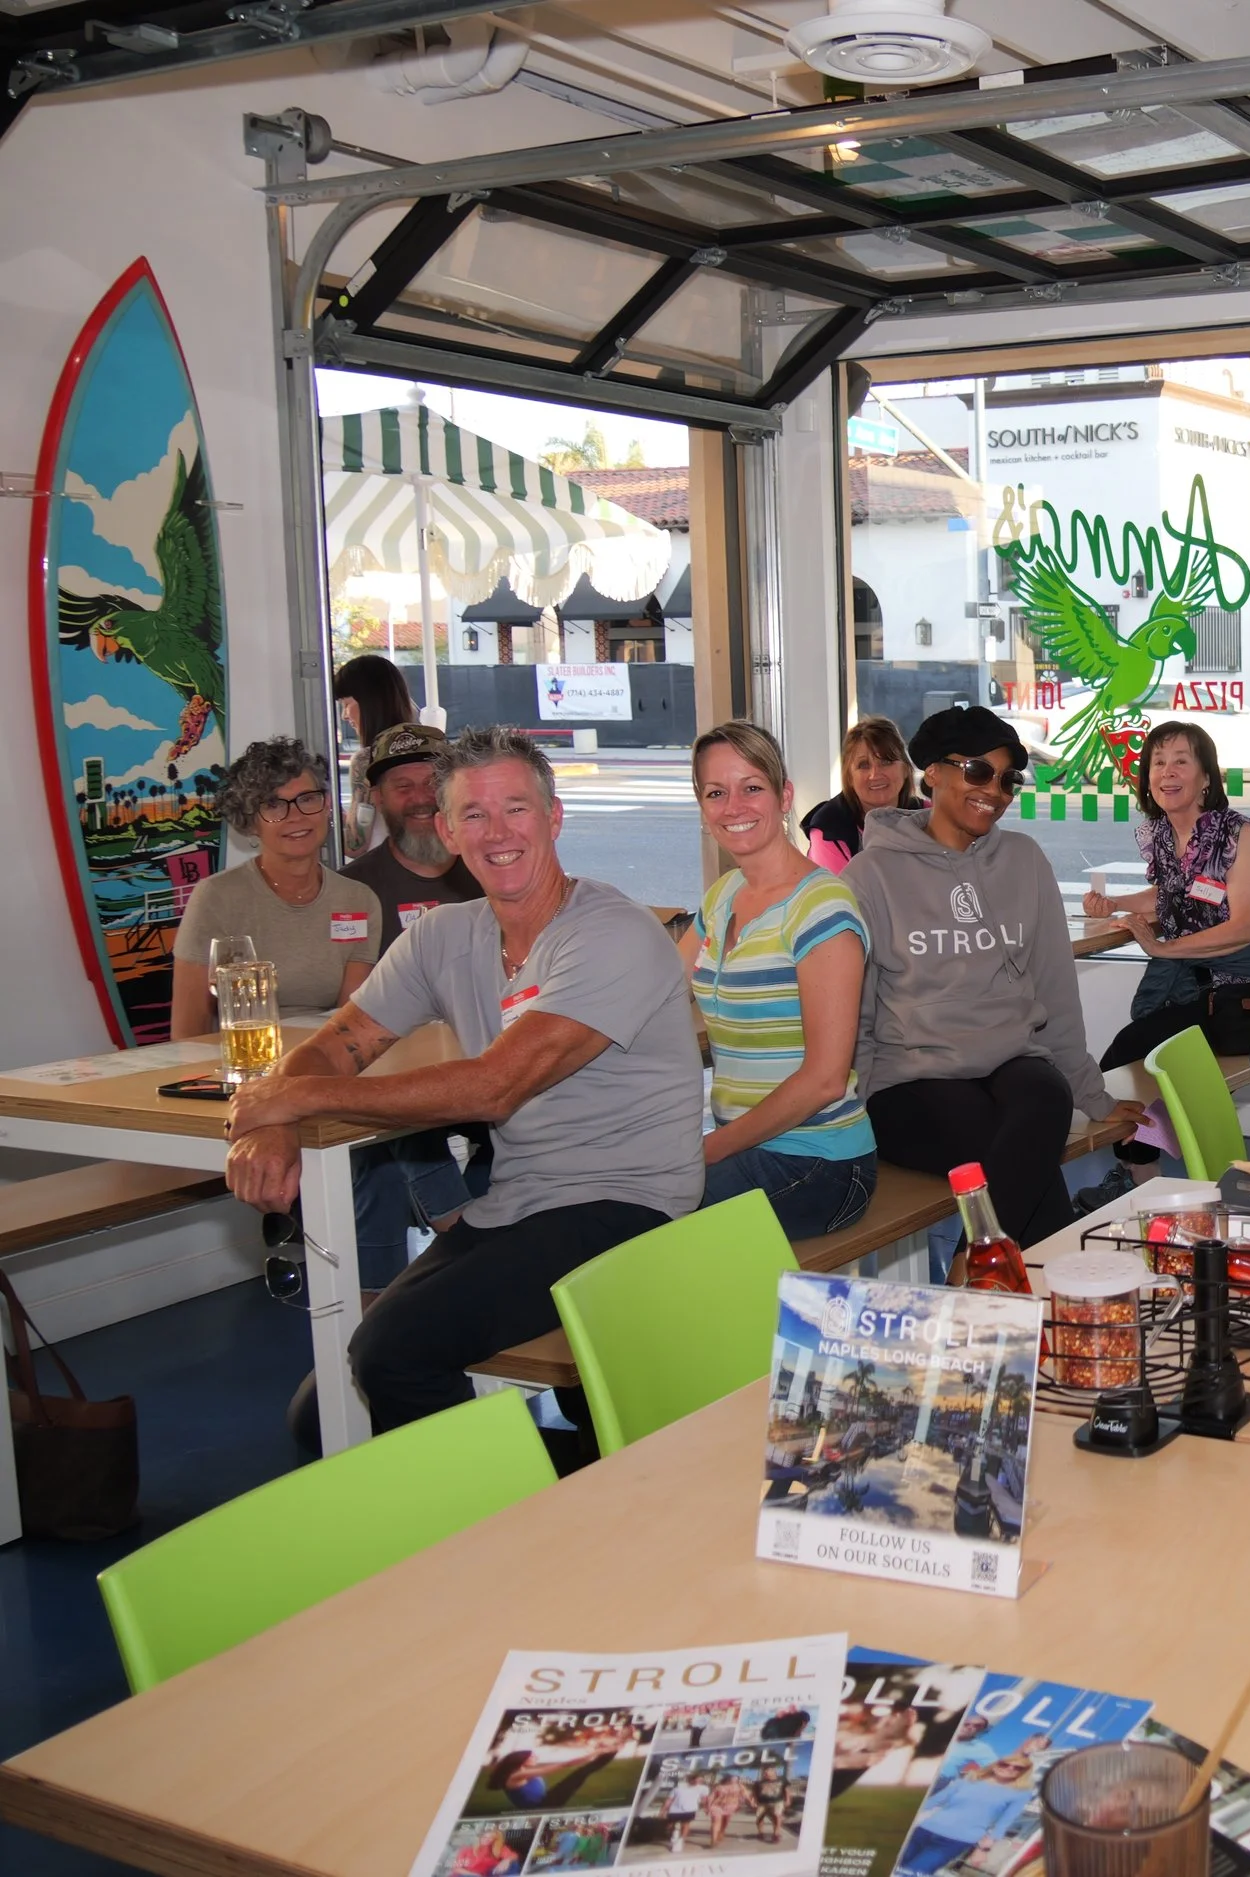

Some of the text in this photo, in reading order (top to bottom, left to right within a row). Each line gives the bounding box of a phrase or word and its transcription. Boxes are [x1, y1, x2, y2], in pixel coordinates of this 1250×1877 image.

[988, 421, 1139, 449] SOUTH of NICK'S
[990, 455, 1022, 465] mexican
[1024, 452, 1052, 462] kitchen
[1061, 449, 1093, 460] cocktail
[1094, 450, 1109, 459] bar
[547, 665, 572, 677] SLATER
[573, 665, 604, 677] BUILDERS
[858, 1309, 983, 1349] STROLL
[818, 1340, 985, 1375] NAPLES LONG BEACH
[840, 1528, 931, 1555] FOLLOW US
[816, 1544, 840, 1560] ON
[844, 1548, 877, 1568] OUR
[882, 1554, 951, 1578] SOCIALS
[524, 1655, 817, 1695] STROLL
[519, 1696, 588, 1707] Naples
[512, 1710, 649, 1730] STROLL
[660, 1747, 799, 1772] STROLL
[460, 1821, 533, 1833] STROLL
